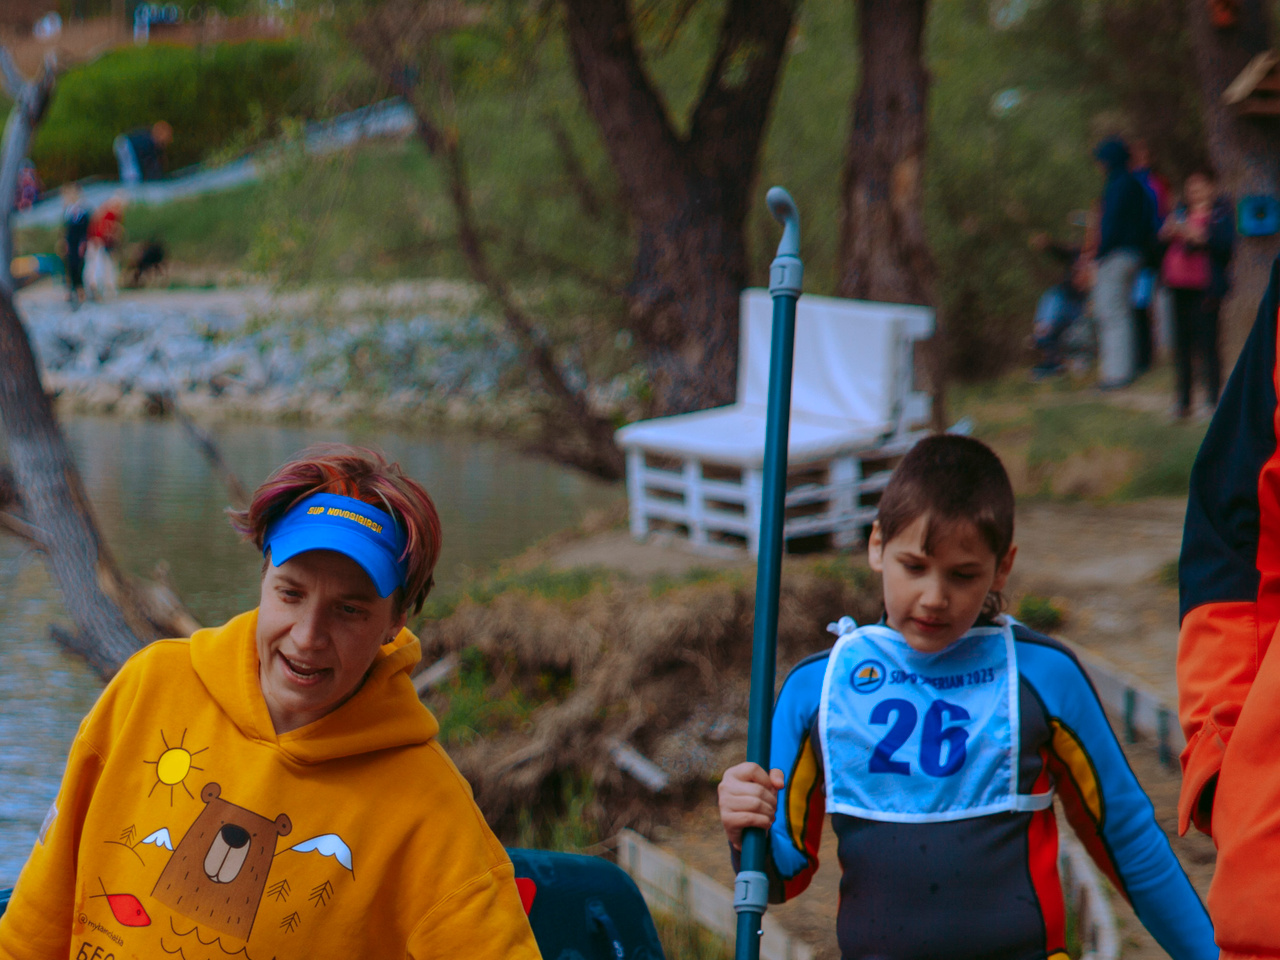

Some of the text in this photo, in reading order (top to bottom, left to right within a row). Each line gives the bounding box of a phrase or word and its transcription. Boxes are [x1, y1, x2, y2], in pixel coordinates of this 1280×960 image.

[307, 506, 383, 534] SUP NOVOSIBIRSK
[966, 667, 995, 685] 2023
[868, 698, 972, 778] 26
